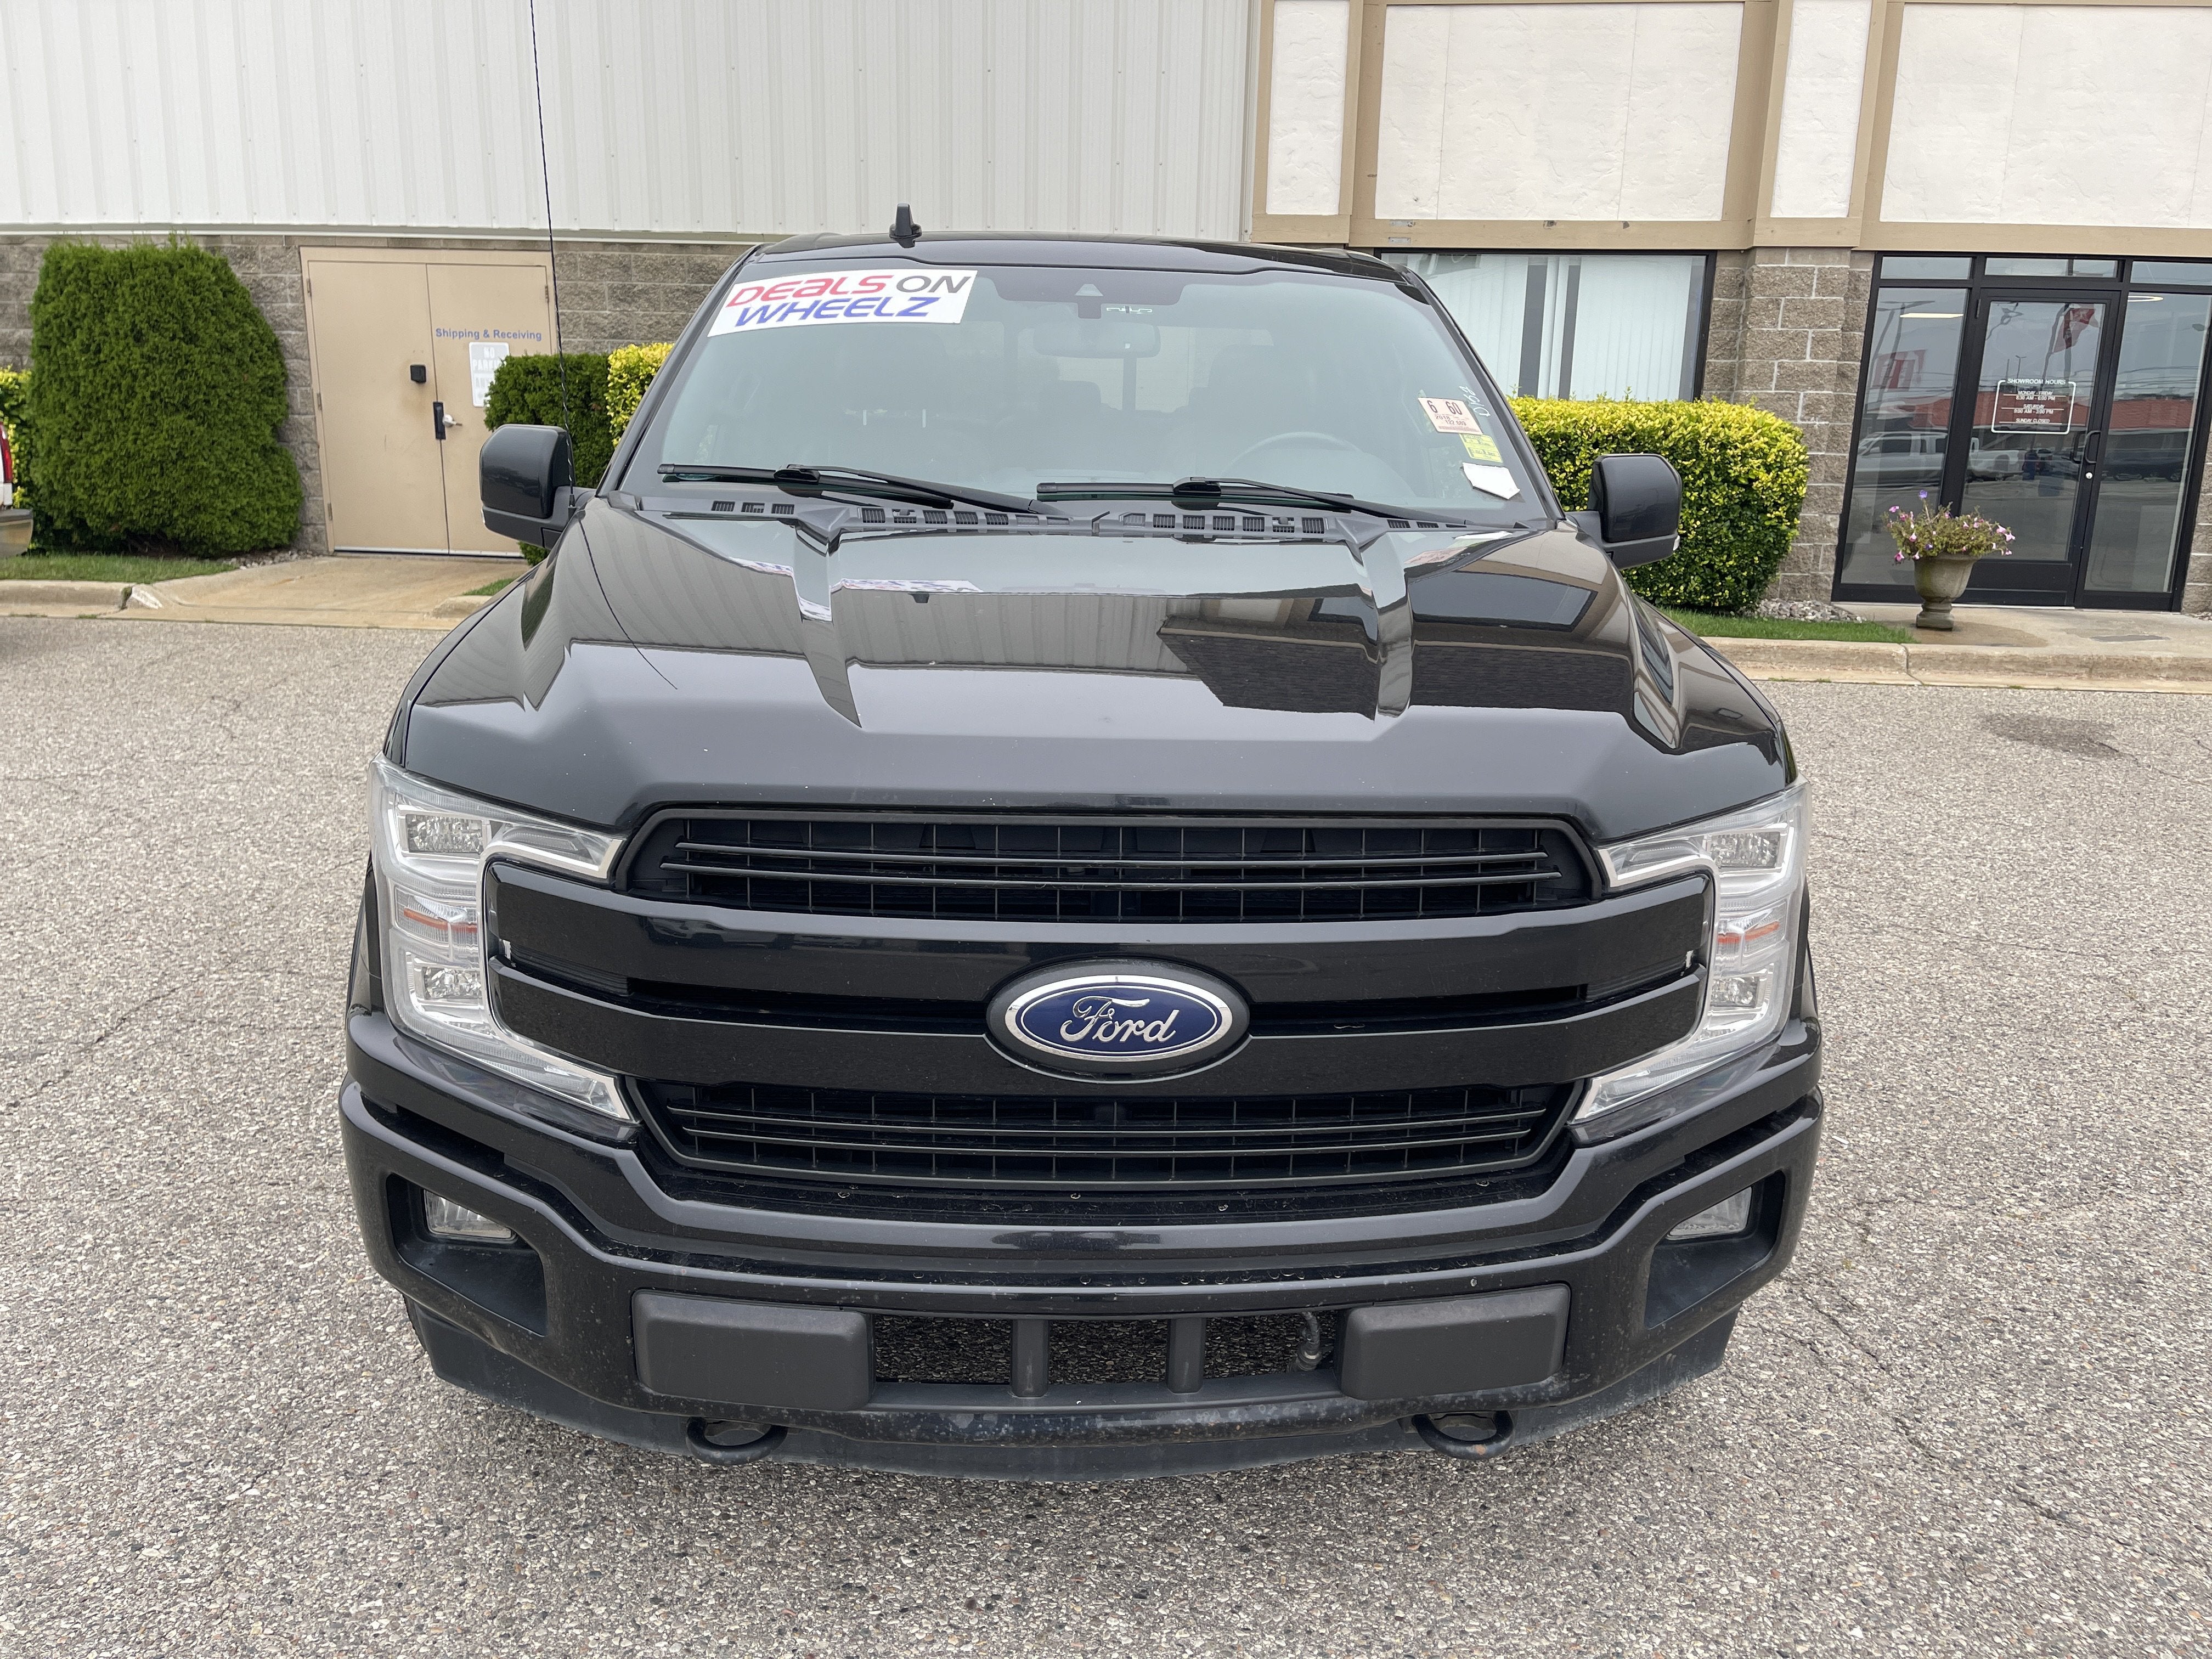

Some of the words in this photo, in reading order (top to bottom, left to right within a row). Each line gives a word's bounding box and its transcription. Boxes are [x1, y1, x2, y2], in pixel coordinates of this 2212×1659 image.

[725, 275, 893, 308] DEALS
[896, 275, 972, 293] ON
[735, 297, 941, 328] WHEELZ
[436, 328, 479, 340] Shipping
[483, 329, 490, 338] &
[494, 329, 542, 342] Receiving
[1427, 400, 1438, 413] 6
[1446, 401, 1462, 415] 60
[1060, 996, 1180, 1042] Ford
